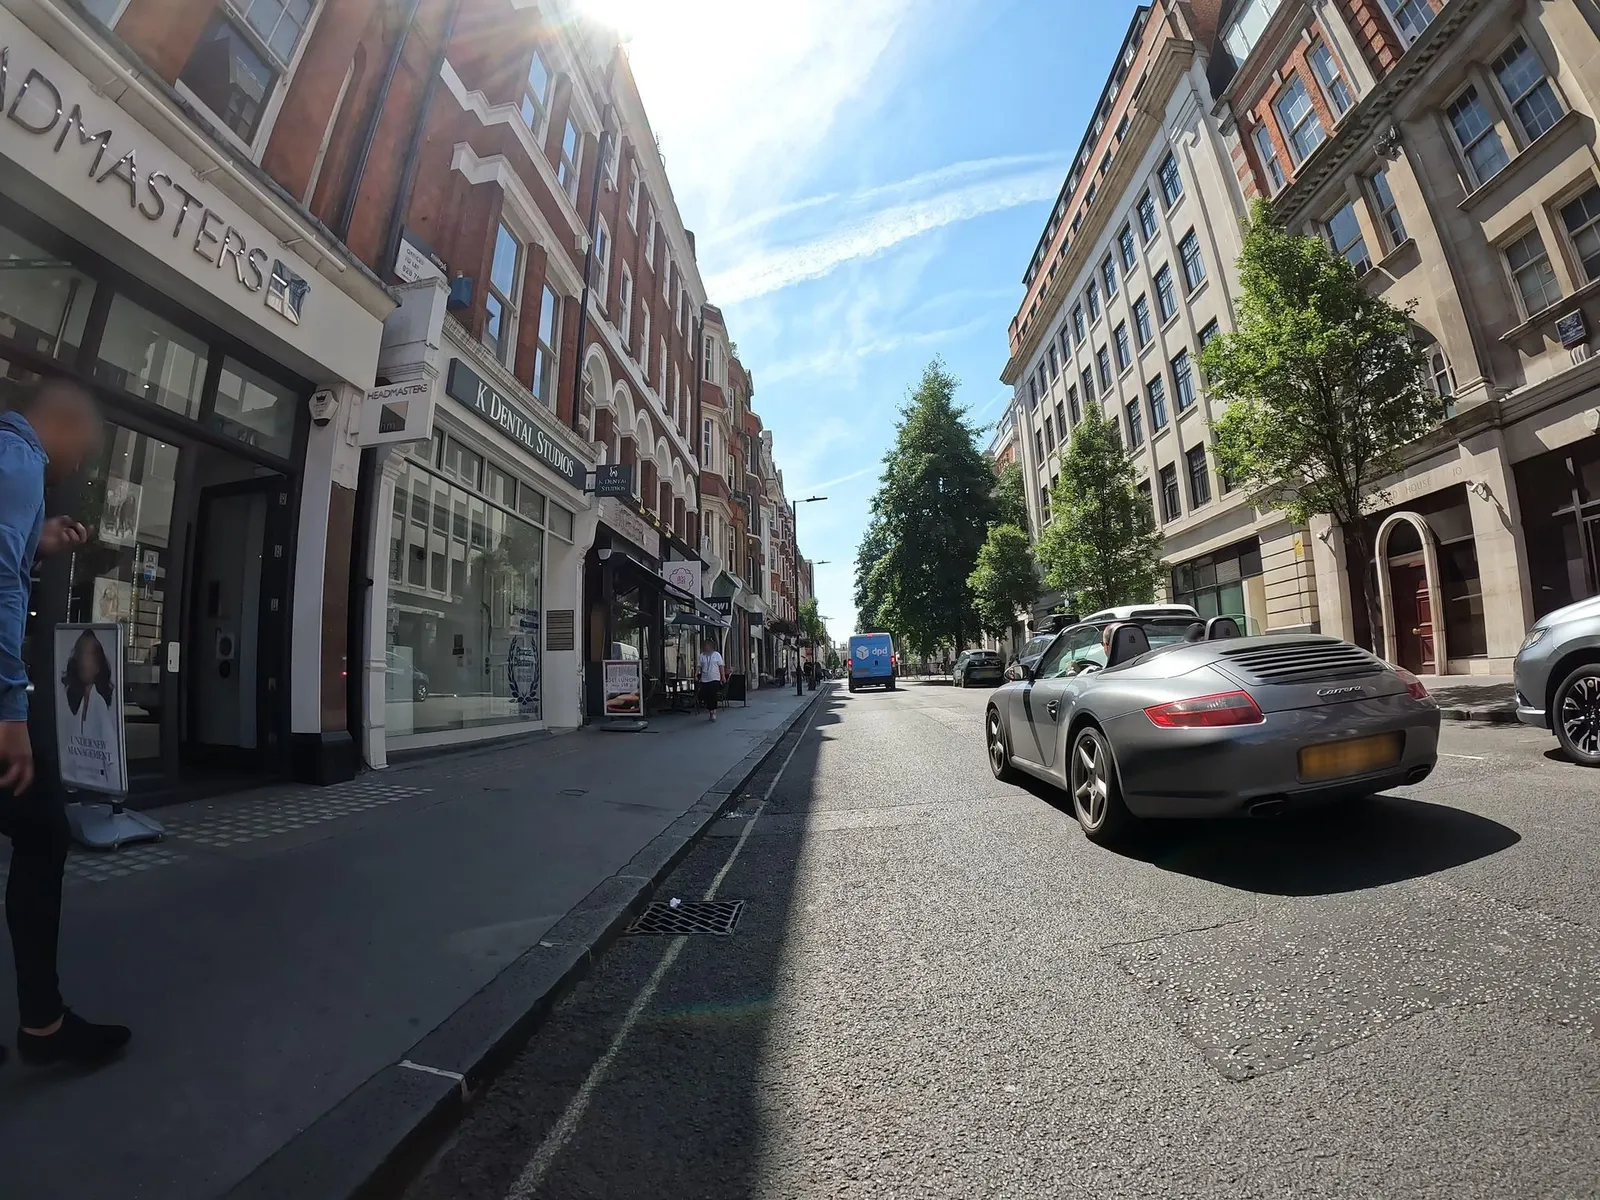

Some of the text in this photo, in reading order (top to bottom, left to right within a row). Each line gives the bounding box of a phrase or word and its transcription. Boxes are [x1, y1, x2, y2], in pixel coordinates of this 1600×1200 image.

[0, 46, 268, 292] DMASTERS
[367, 384, 427, 400] HEADMASTERS
[475, 381, 574, 478] K DENTAL STUDIOS
[1404, 467, 1462, 495] HOUSE 10
[871, 646, 888, 657] dpd
[1316, 685, 1361, 696] Carrera
[67, 746, 112, 762] MANAGEMENT
